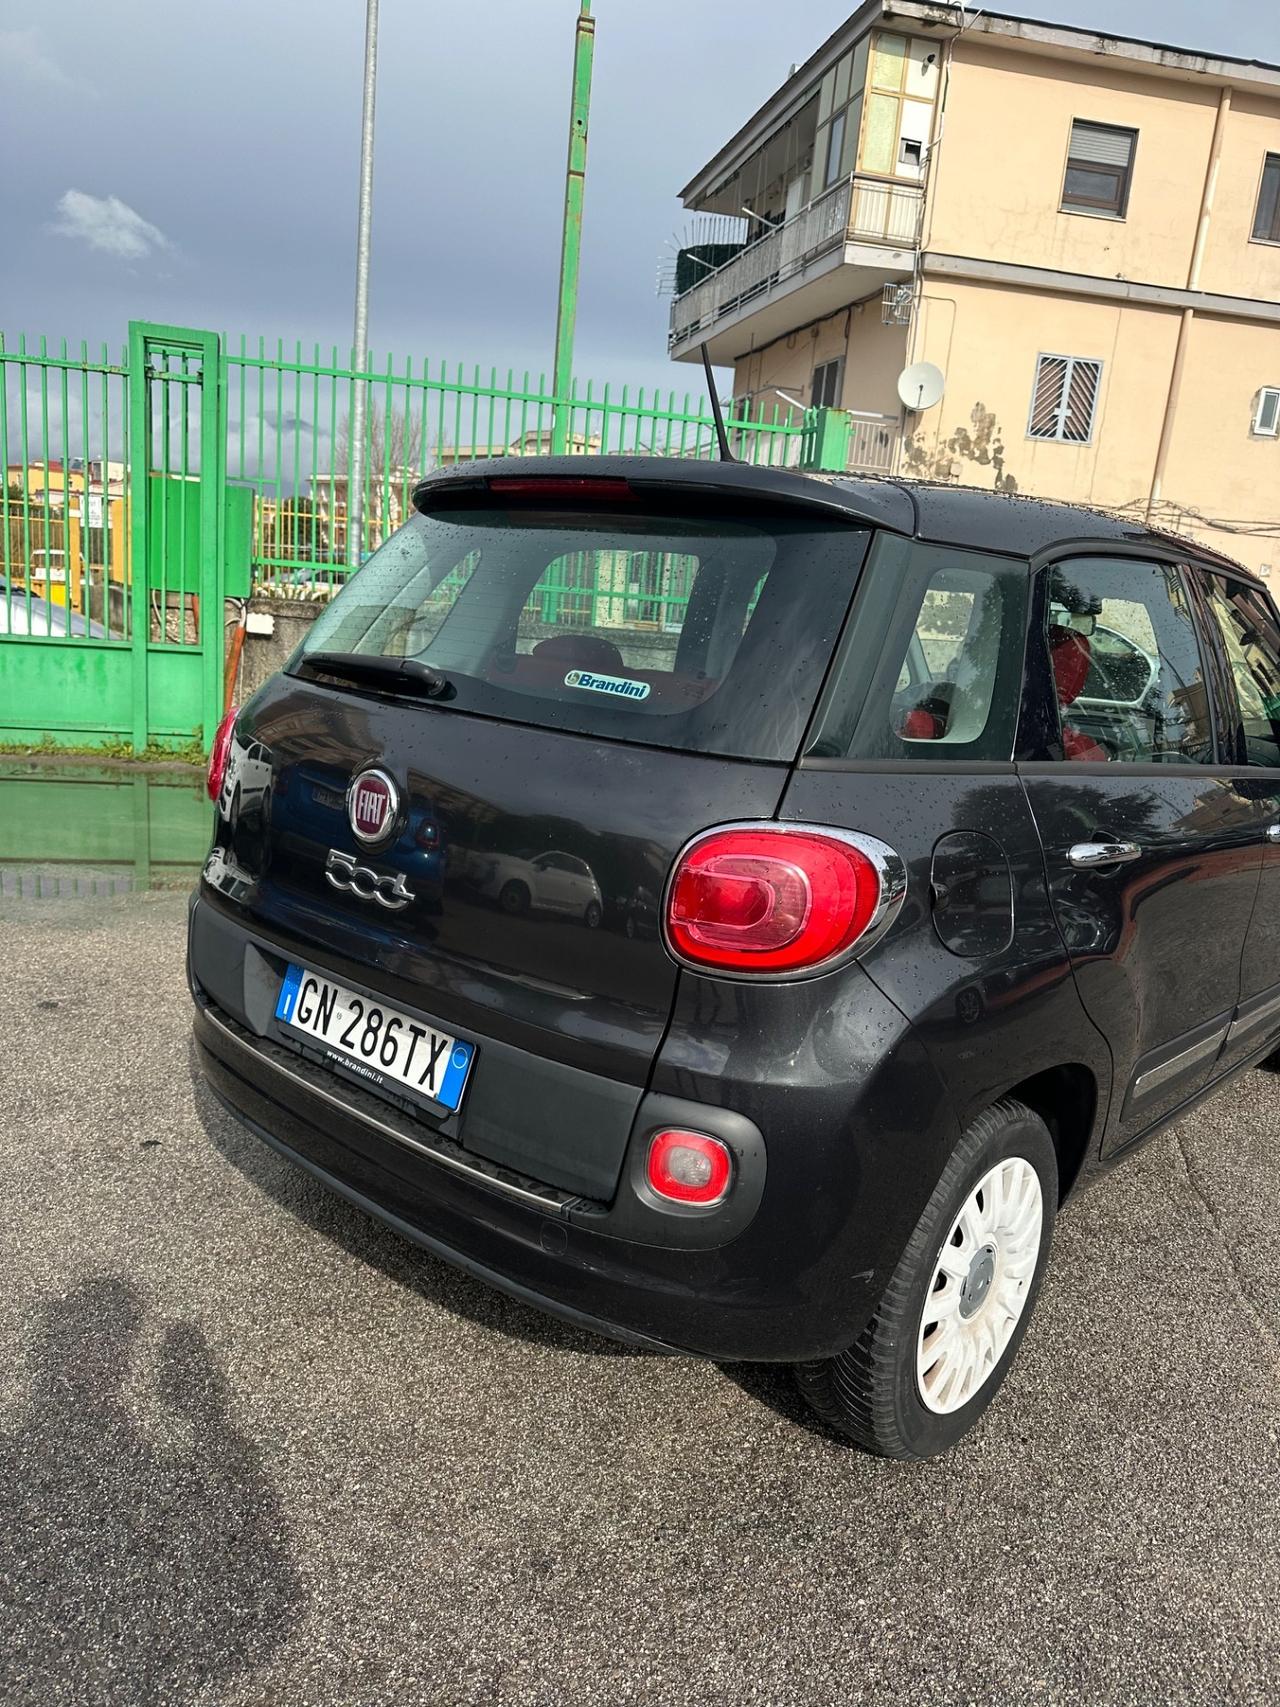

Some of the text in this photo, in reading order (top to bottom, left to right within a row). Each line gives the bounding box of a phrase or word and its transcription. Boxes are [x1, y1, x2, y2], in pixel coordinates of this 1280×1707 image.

[578, 674, 647, 697] Brandini
[356, 789, 386, 825] FIAT
[297, 977, 448, 1091] GN 286TX
[326, 1050, 384, 1084] www.brandini.it
